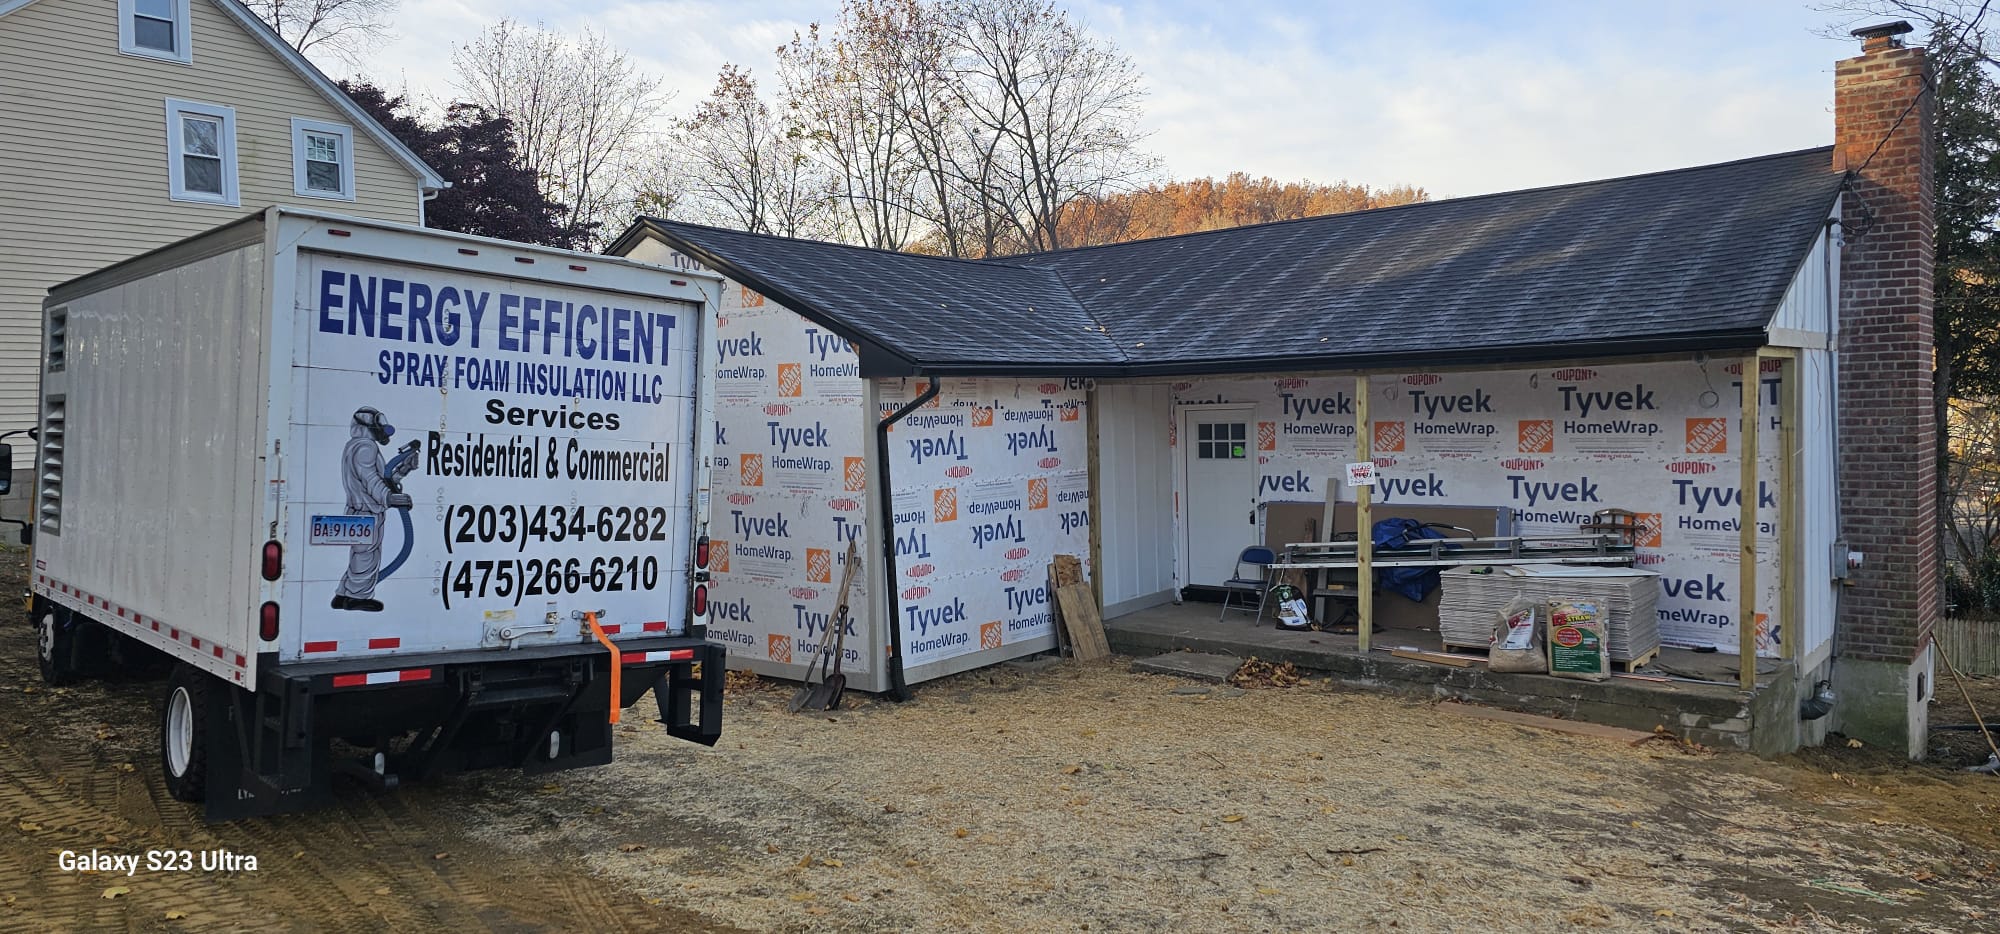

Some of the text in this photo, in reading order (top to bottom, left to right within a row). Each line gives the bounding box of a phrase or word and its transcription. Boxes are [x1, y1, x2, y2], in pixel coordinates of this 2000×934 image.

[319, 270, 677, 366] ENERGY EFFICIENT
[717, 331, 762, 364] yvek
[805, 329, 853, 361] Tyve
[378, 350, 663, 404] SPRAY FOAM INSULATION LLC
[716, 366, 765, 381] omeWrap
[810, 364, 858, 378] HomeWr
[1407, 374, 1438, 385] DUPONT
[1556, 368, 1592, 381] DUPONT
[766, 404, 789, 417] DUPONT
[1281, 391, 1353, 420] Tyvek
[1408, 389, 1492, 420] Tyvek
[1558, 384, 1655, 418] Tyvek
[485, 399, 620, 431] Services
[906, 414, 963, 429] HomeWrap
[1004, 409, 1053, 423] HomeWrap
[767, 421, 828, 453] Tyvek
[1284, 422, 1355, 437] HomeWrap
[1414, 422, 1494, 437] HomeWrap
[1564, 420, 1658, 436] HomeWrap
[910, 430, 968, 464] Tyvek
[1007, 424, 1057, 456] Tyvek
[427, 431, 670, 482] Residential & Commercial
[772, 456, 831, 473] HomeWrap
[1506, 458, 1541, 471] DUPONT
[1671, 462, 1710, 474] DUPONT
[1259, 471, 1311, 496] yvek
[1507, 476, 1599, 506] Tyvek
[831, 500, 857, 511] DUPONT
[969, 500, 1021, 514] HomeWrap
[1058, 490, 1089, 503] meWrap
[731, 510, 789, 541] Tyvek
[894, 511, 925, 523] Home
[1061, 511, 1089, 535] vek
[444, 504, 667, 554] (203)434-6282
[973, 514, 1025, 549] Tyvek
[735, 544, 792, 561] HomeWrap
[895, 528, 930, 559] Tyv
[1635, 554, 1660, 565] PONT
[441, 556, 658, 609] (475)266-6210
[904, 587, 928, 600] DUPONT
[1660, 574, 1726, 601] vek
[707, 598, 751, 624] yvek
[906, 597, 965, 636] Tyvek
[1657, 609, 1729, 628] meWrap
[705, 629, 754, 646] omeWrap
[911, 632, 968, 654] HomeWrap
